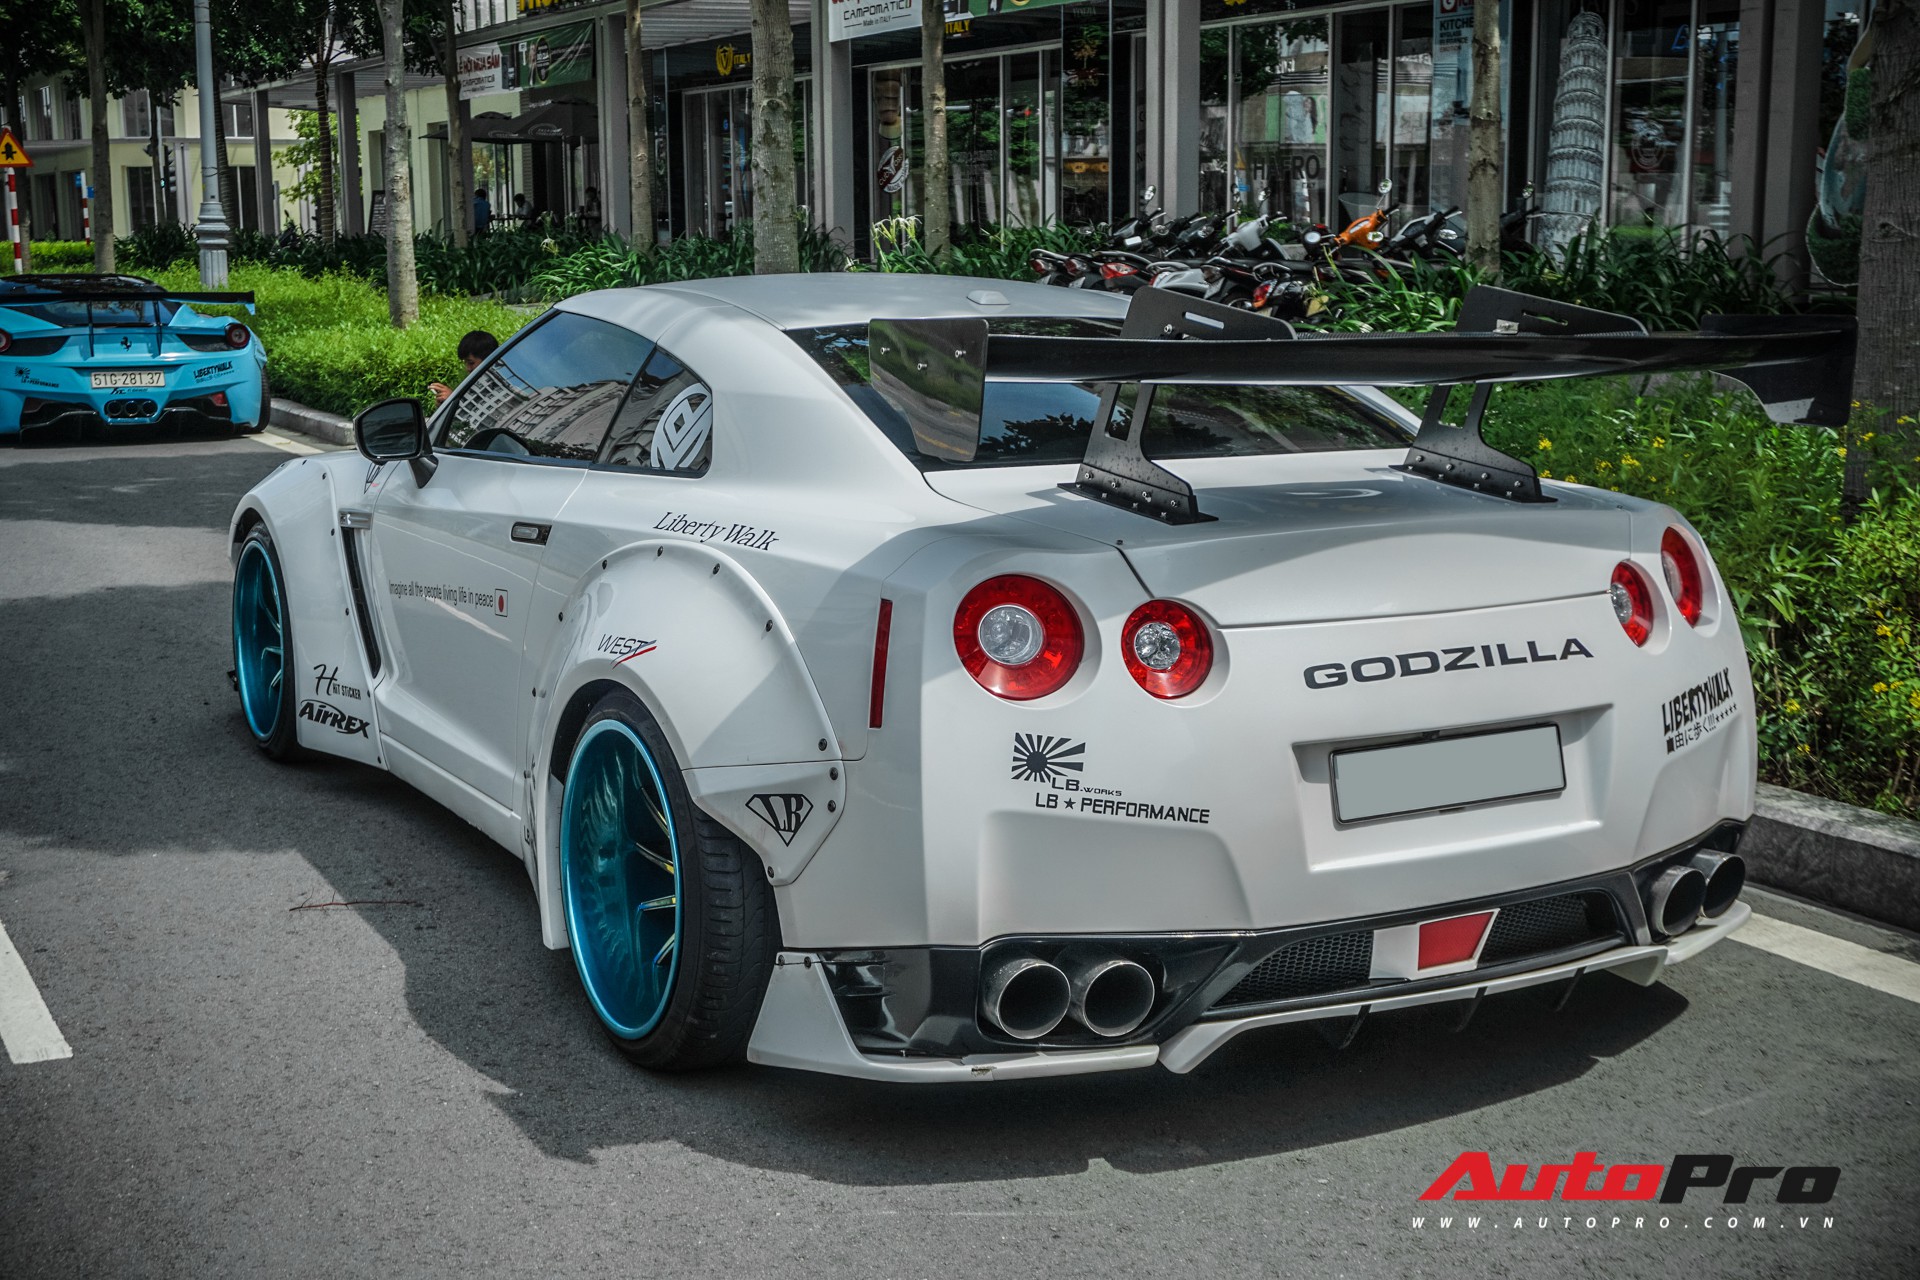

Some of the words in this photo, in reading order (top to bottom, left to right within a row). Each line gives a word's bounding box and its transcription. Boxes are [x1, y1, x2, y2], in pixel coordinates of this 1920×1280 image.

[1440, 17, 1474, 31] KITCHE
[93, 372, 163, 387] 51G-281.37
[653, 511, 727, 543] Liberty
[723, 523, 779, 551] Walk
[424, 584, 442, 602] people
[443, 584, 458, 606] living
[458, 586, 467, 604] life
[468, 588, 474, 604] in
[474, 592, 494, 609] peace
[597, 633, 649, 656] WEST
[1303, 638, 1595, 690] GODZILLA
[1662, 667, 1734, 737] LIBERTYWALK
[1080, 797, 1211, 824] PERFORMANCE
